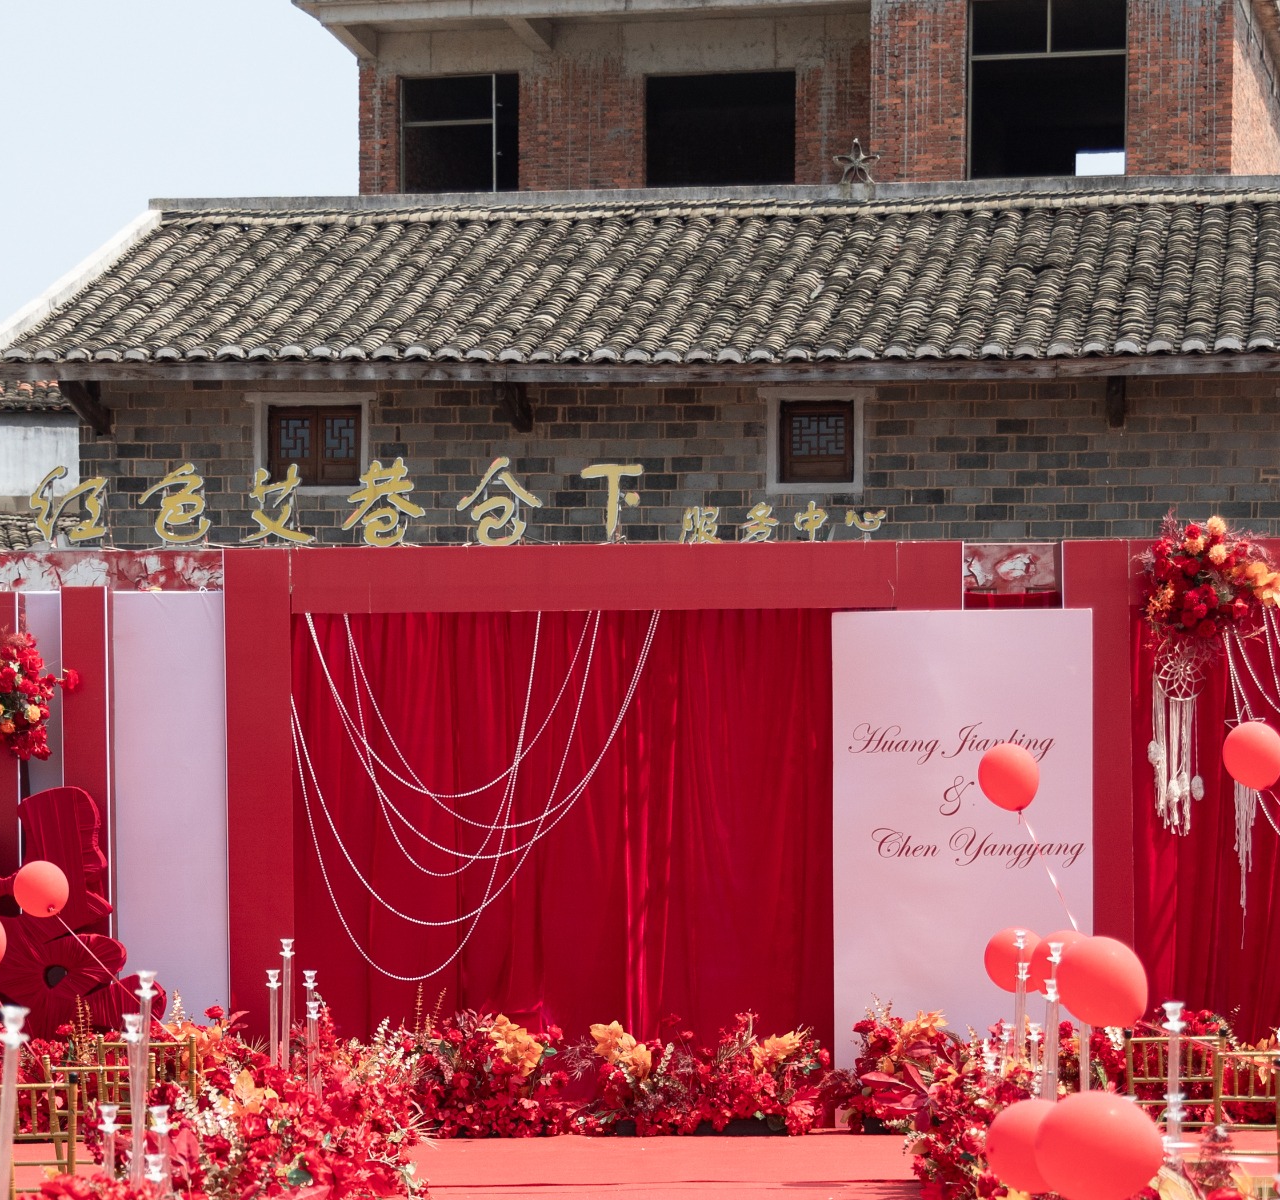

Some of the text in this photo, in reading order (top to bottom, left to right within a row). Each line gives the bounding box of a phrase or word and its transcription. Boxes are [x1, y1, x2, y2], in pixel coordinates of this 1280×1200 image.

[678, 501, 887, 544] 服务中心
[847, 722, 941, 766] Huang
[939, 775, 976, 817] &
[870, 826, 1087, 869] Chen Yangyang
